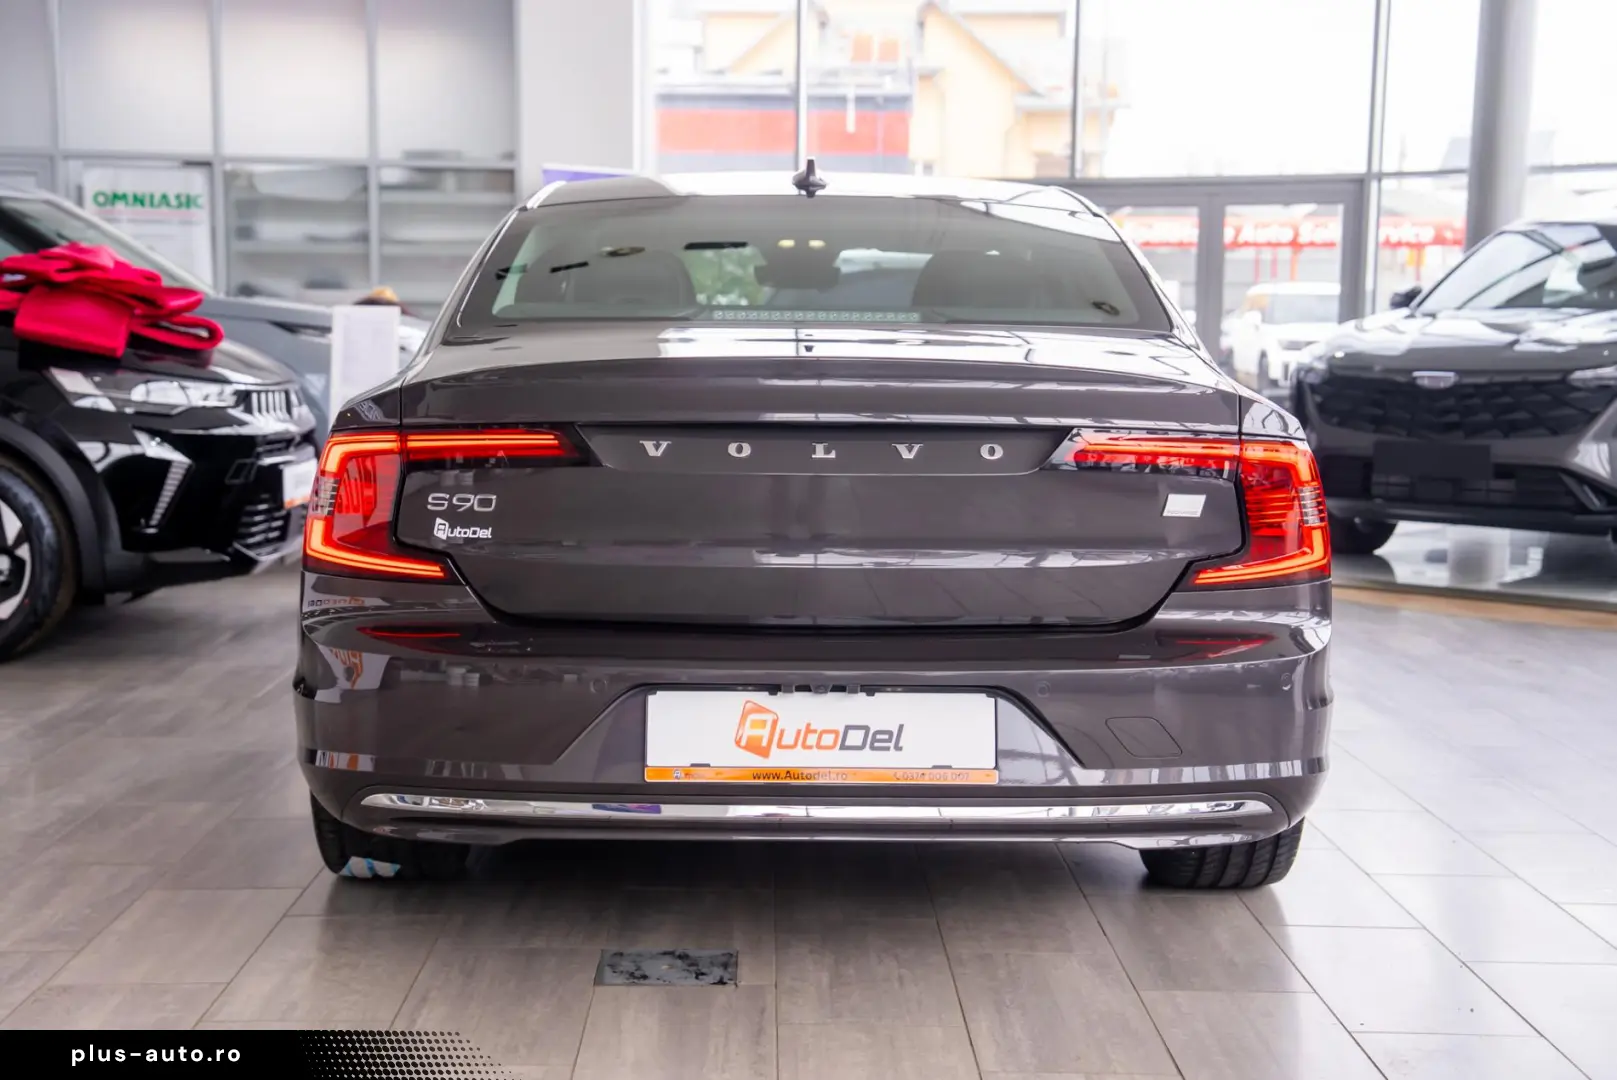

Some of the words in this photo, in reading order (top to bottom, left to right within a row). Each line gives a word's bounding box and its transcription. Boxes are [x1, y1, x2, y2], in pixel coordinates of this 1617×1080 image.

[639, 440, 1004, 460] VOLVO
[426, 492, 498, 513] S90
[433, 516, 493, 541] AutoDel
[734, 699, 905, 760] AutoDel
[752, 770, 848, 781] www.Autodel.ro
